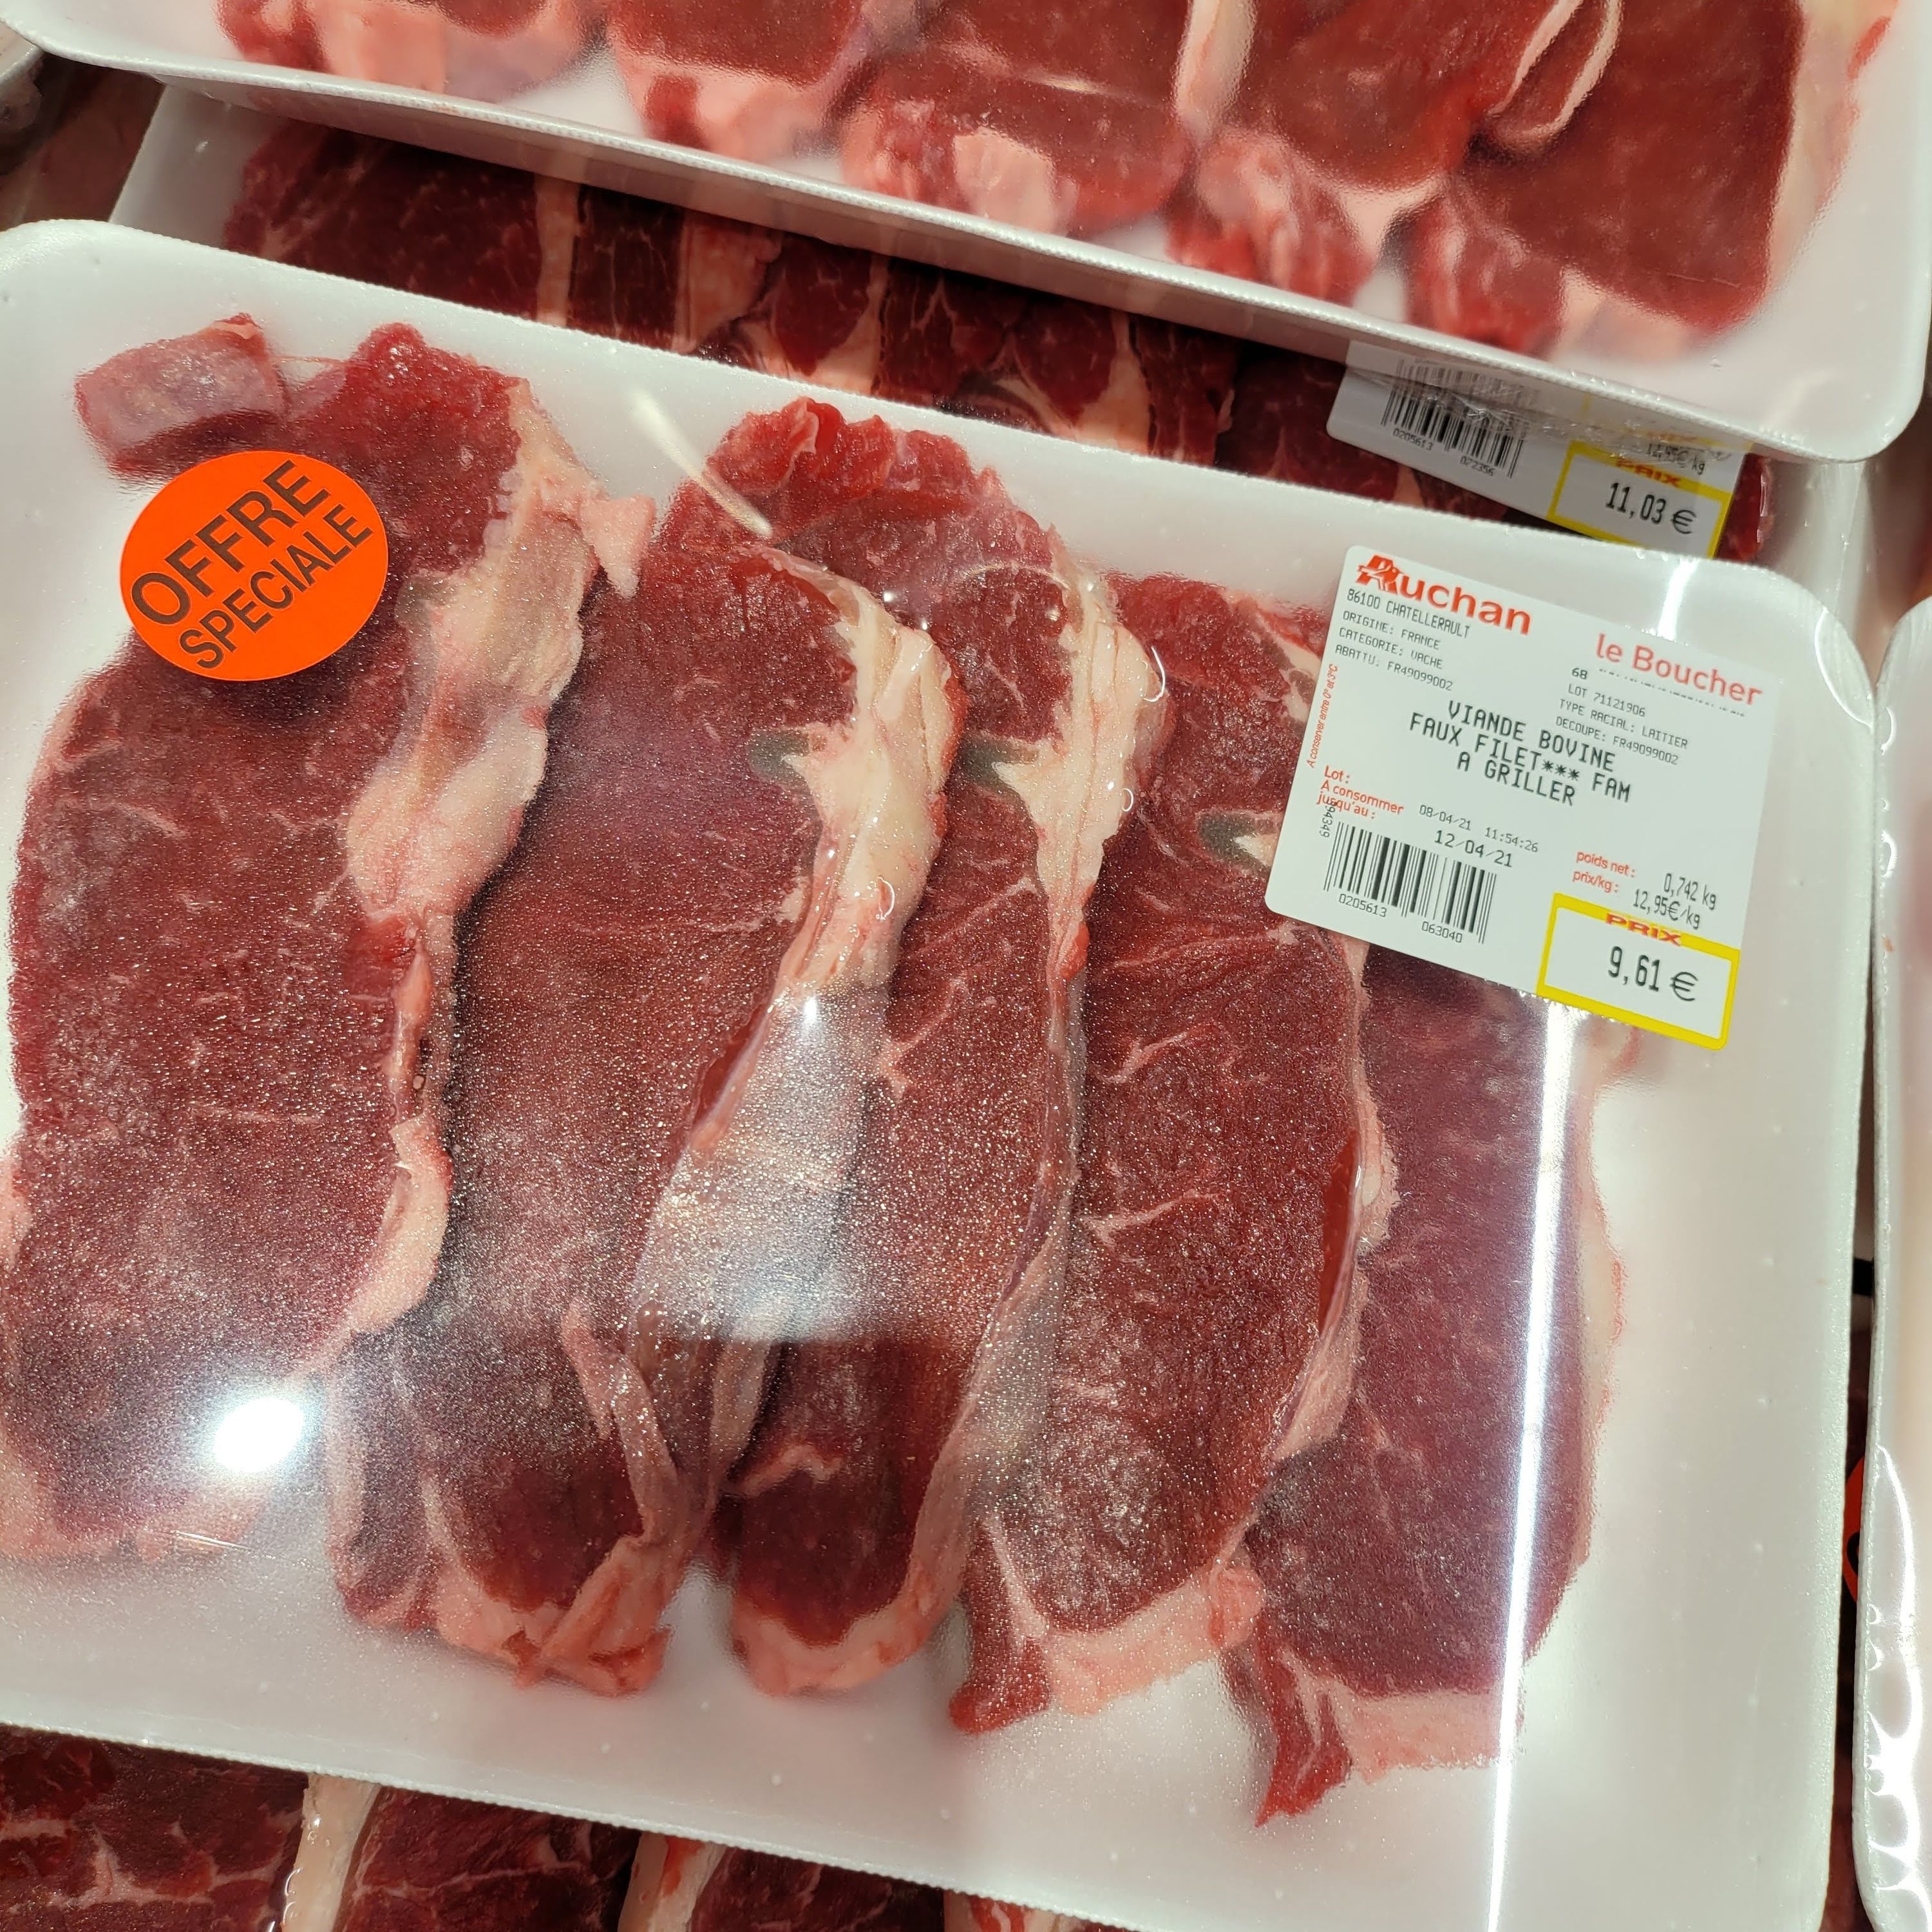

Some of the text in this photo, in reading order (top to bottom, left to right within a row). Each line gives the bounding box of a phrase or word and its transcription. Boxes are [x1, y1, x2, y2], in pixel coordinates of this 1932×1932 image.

[1616, 458, 1681, 488] PRIX
[1605, 482, 1697, 535] 11,03 €
[131, 459, 331, 625] OFFRE
[178, 504, 373, 669] SPECIALE
[1355, 554, 1531, 636] Auchan
[1343, 611, 1441, 650] ORIGINE: FRANCE
[1347, 588, 1470, 638] 86100 CHATELLERAULT
[1335, 644, 1454, 691] ABATTU: FR49099002
[1339, 627, 1443, 670] CATEGORIE: VACHE
[1596, 633, 1623, 663] le
[1632, 645, 1762, 705] Boucher
[1571, 667, 1588, 680] 68
[1568, 683, 1646, 717] LOT 71121906
[1310, 722, 1325, 759] conserver
[1320, 698, 1331, 721] entre
[1448, 700, 1616, 772] VIANDE BOVINE
[1556, 716, 1679, 765] DECOUPE: FR49099002
[1559, 699, 1688, 750] TYPE RACIAL: LAITIER
[1410, 712, 1462, 747] FAUX
[1592, 772, 1631, 803] FAM
[1457, 752, 1575, 806] A GRILLER
[1321, 780, 1404, 815] A consommer
[1419, 804, 1539, 853] 08/04/21 11:54:26
[1434, 830, 1513, 867] 12/04/21
[1576, 851, 1608, 869] poids
[1338, 893, 1387, 918] 0205613
[1633, 889, 1700, 930] 12,95€/kg
[1664, 873, 1716, 911] 0,742 kg
[1421, 921, 1463, 943] 063040
[1605, 913, 1681, 947] PRIX
[1608, 946, 1698, 1002] 9,61 €
